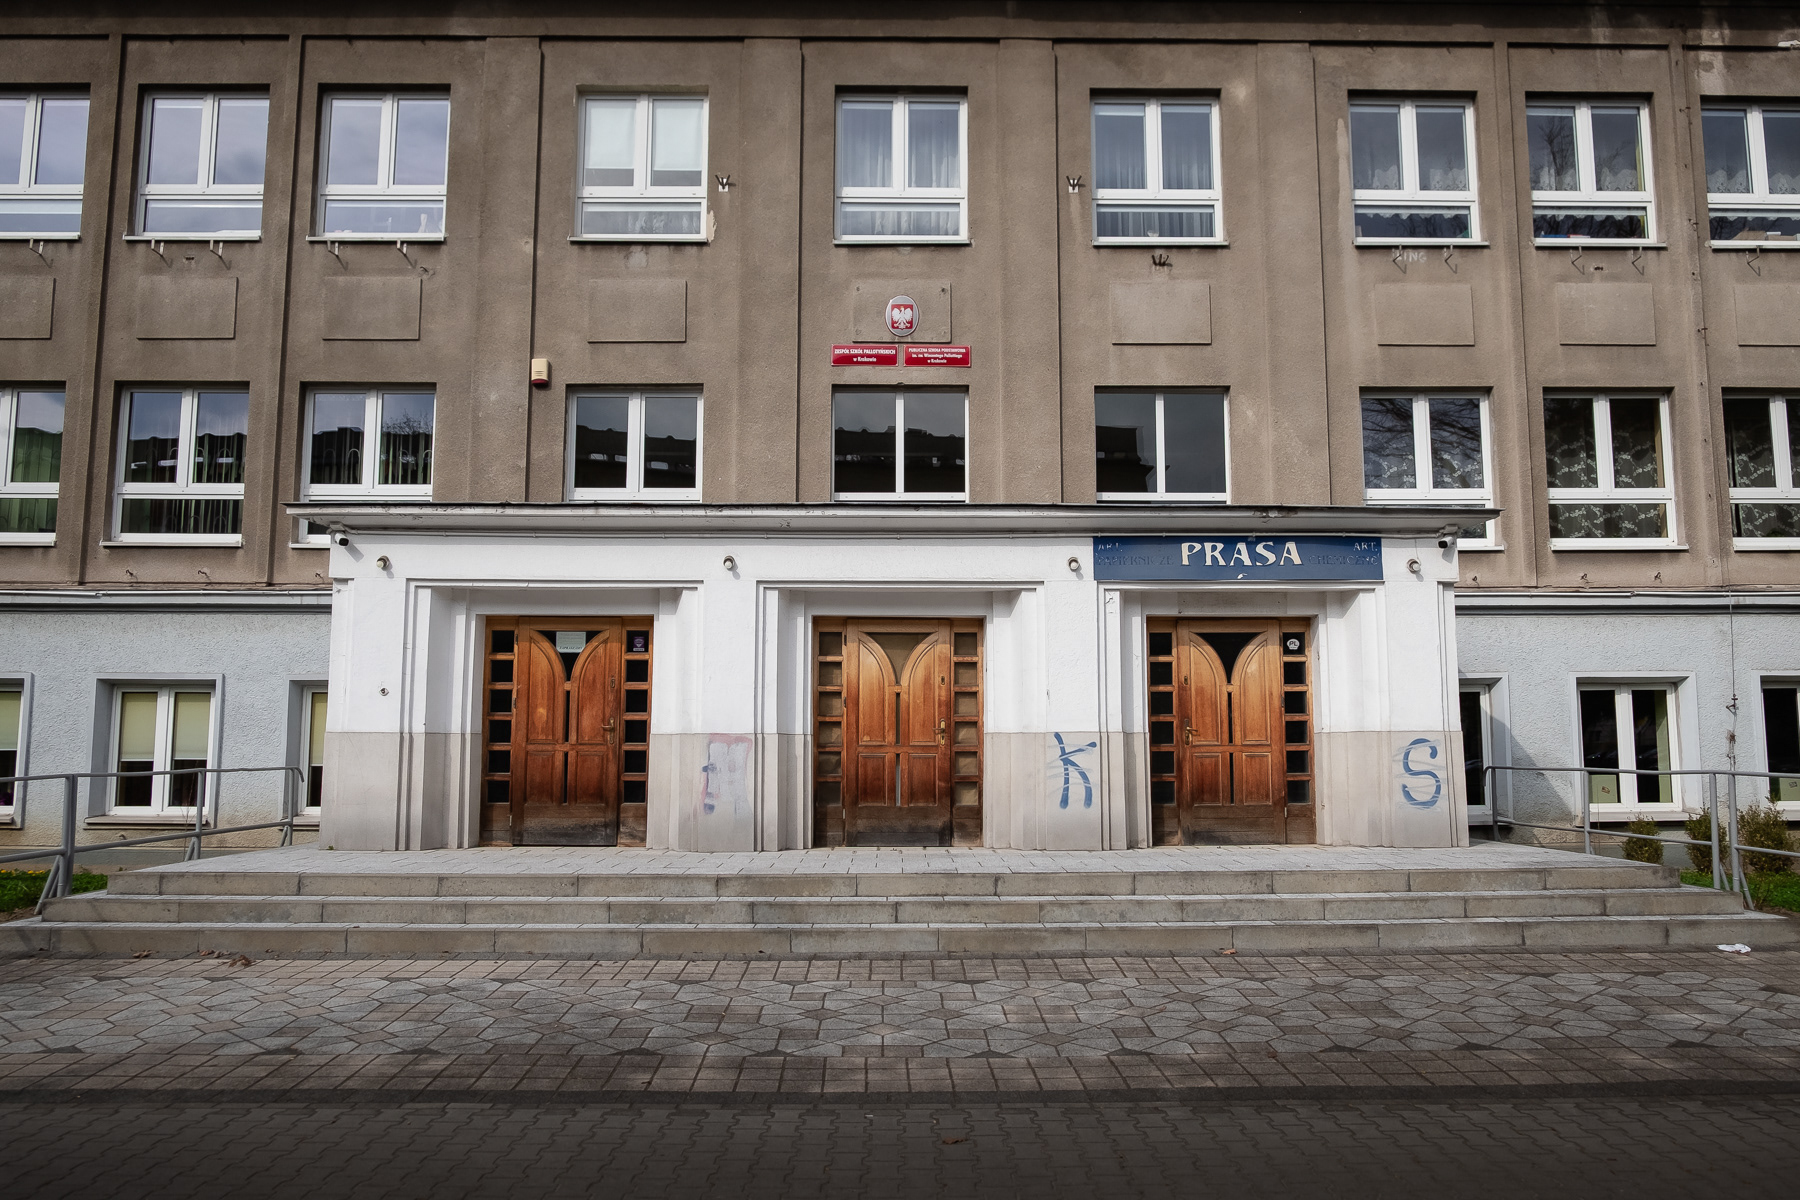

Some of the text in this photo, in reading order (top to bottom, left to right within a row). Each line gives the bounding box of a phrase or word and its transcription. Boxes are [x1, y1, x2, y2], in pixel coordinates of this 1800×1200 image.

[1181, 541, 1304, 567] PRASA
[1353, 541, 1379, 552] ART.
[1053, 731, 1098, 810] K
[1401, 737, 1442, 810] S
